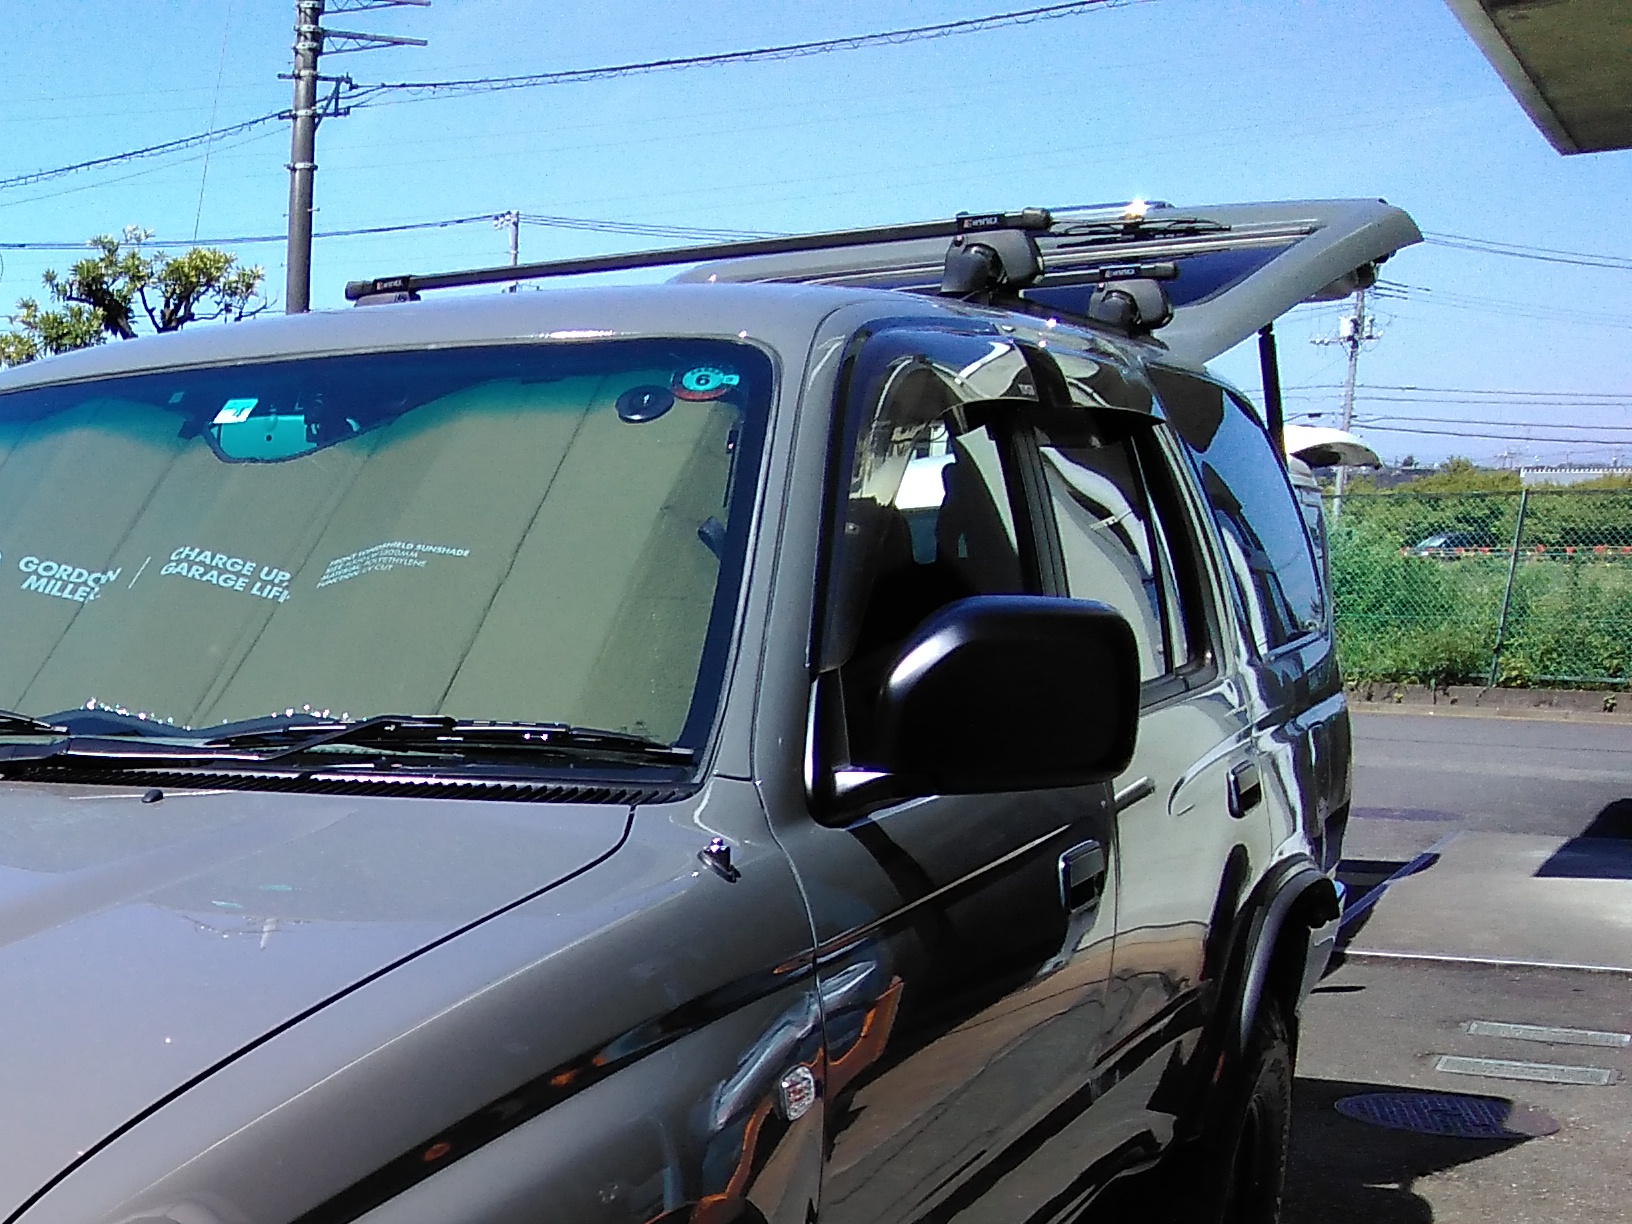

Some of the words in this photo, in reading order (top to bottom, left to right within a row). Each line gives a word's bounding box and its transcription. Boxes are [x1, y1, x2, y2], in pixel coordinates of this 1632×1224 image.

[695, 374, 711, 387] 6
[170, 546, 257, 576] CHARGE
[416, 543, 470, 558] SUNSHADE
[18, 556, 122, 588] GORDON
[160, 562, 250, 592] GARAGE
